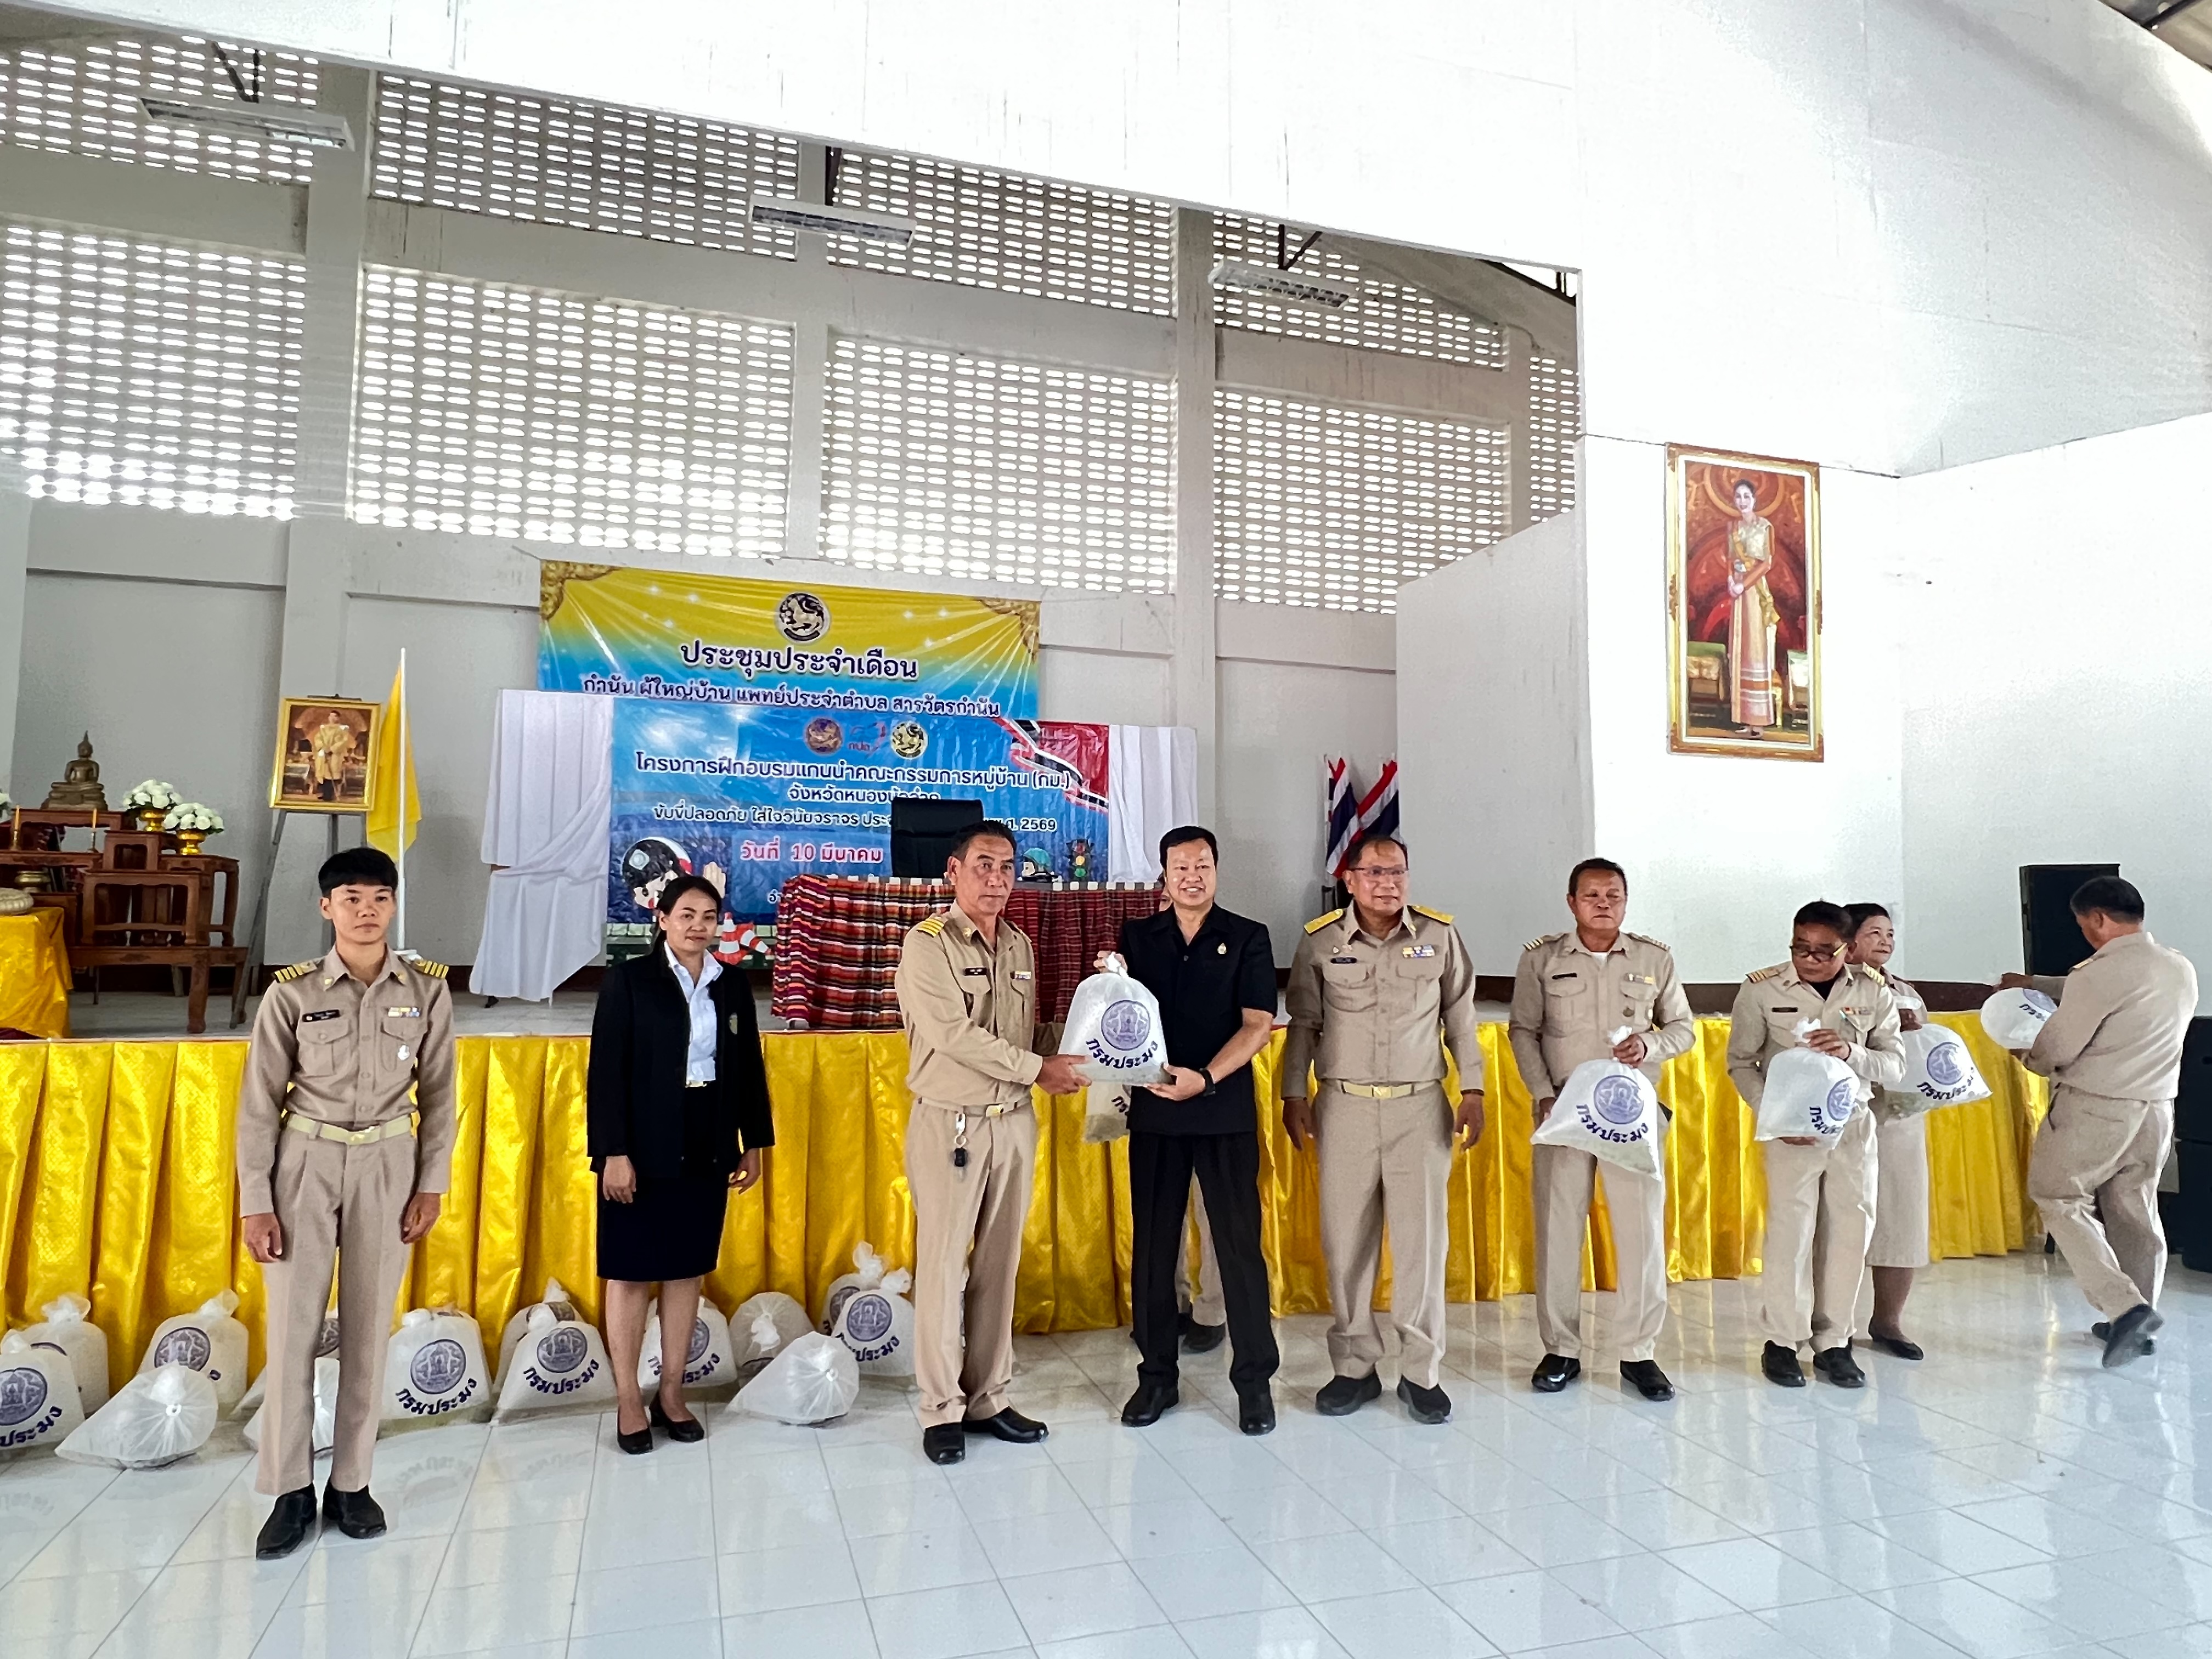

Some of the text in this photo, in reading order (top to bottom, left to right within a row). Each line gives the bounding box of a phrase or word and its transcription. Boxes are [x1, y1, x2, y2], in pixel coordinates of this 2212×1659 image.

[680, 640, 917, 678] ประชุมประจำเดือน
[584, 674, 1000, 716] กำนัน ผ้ใหญ่บ้าน แพทย์ประจำตำบล สารวัตรกำนัน
[636, 752, 1070, 789] โครงการฝึกอบรมแกนนำคณะกรรมการหมู่บ้าน (กม.)
[654, 799, 747, 821] ขับขี่ปลอดภัย
[751, 806, 858, 825] ใส่ใจวินัยจราจร
[1021, 819, 1056, 830] 2569
[741, 837, 882, 862] วันที่ 10 มีนาคม
[1085, 1039, 1159, 1069] กรมประมง
[1917, 1066, 1974, 1100] กรมประม
[1576, 1104, 1649, 1143] กรมประมง
[523, 1358, 599, 1395] กรมประมง
[396, 1378, 477, 1415] กรมประมง
[0, 1406, 63, 1447] ประมง
